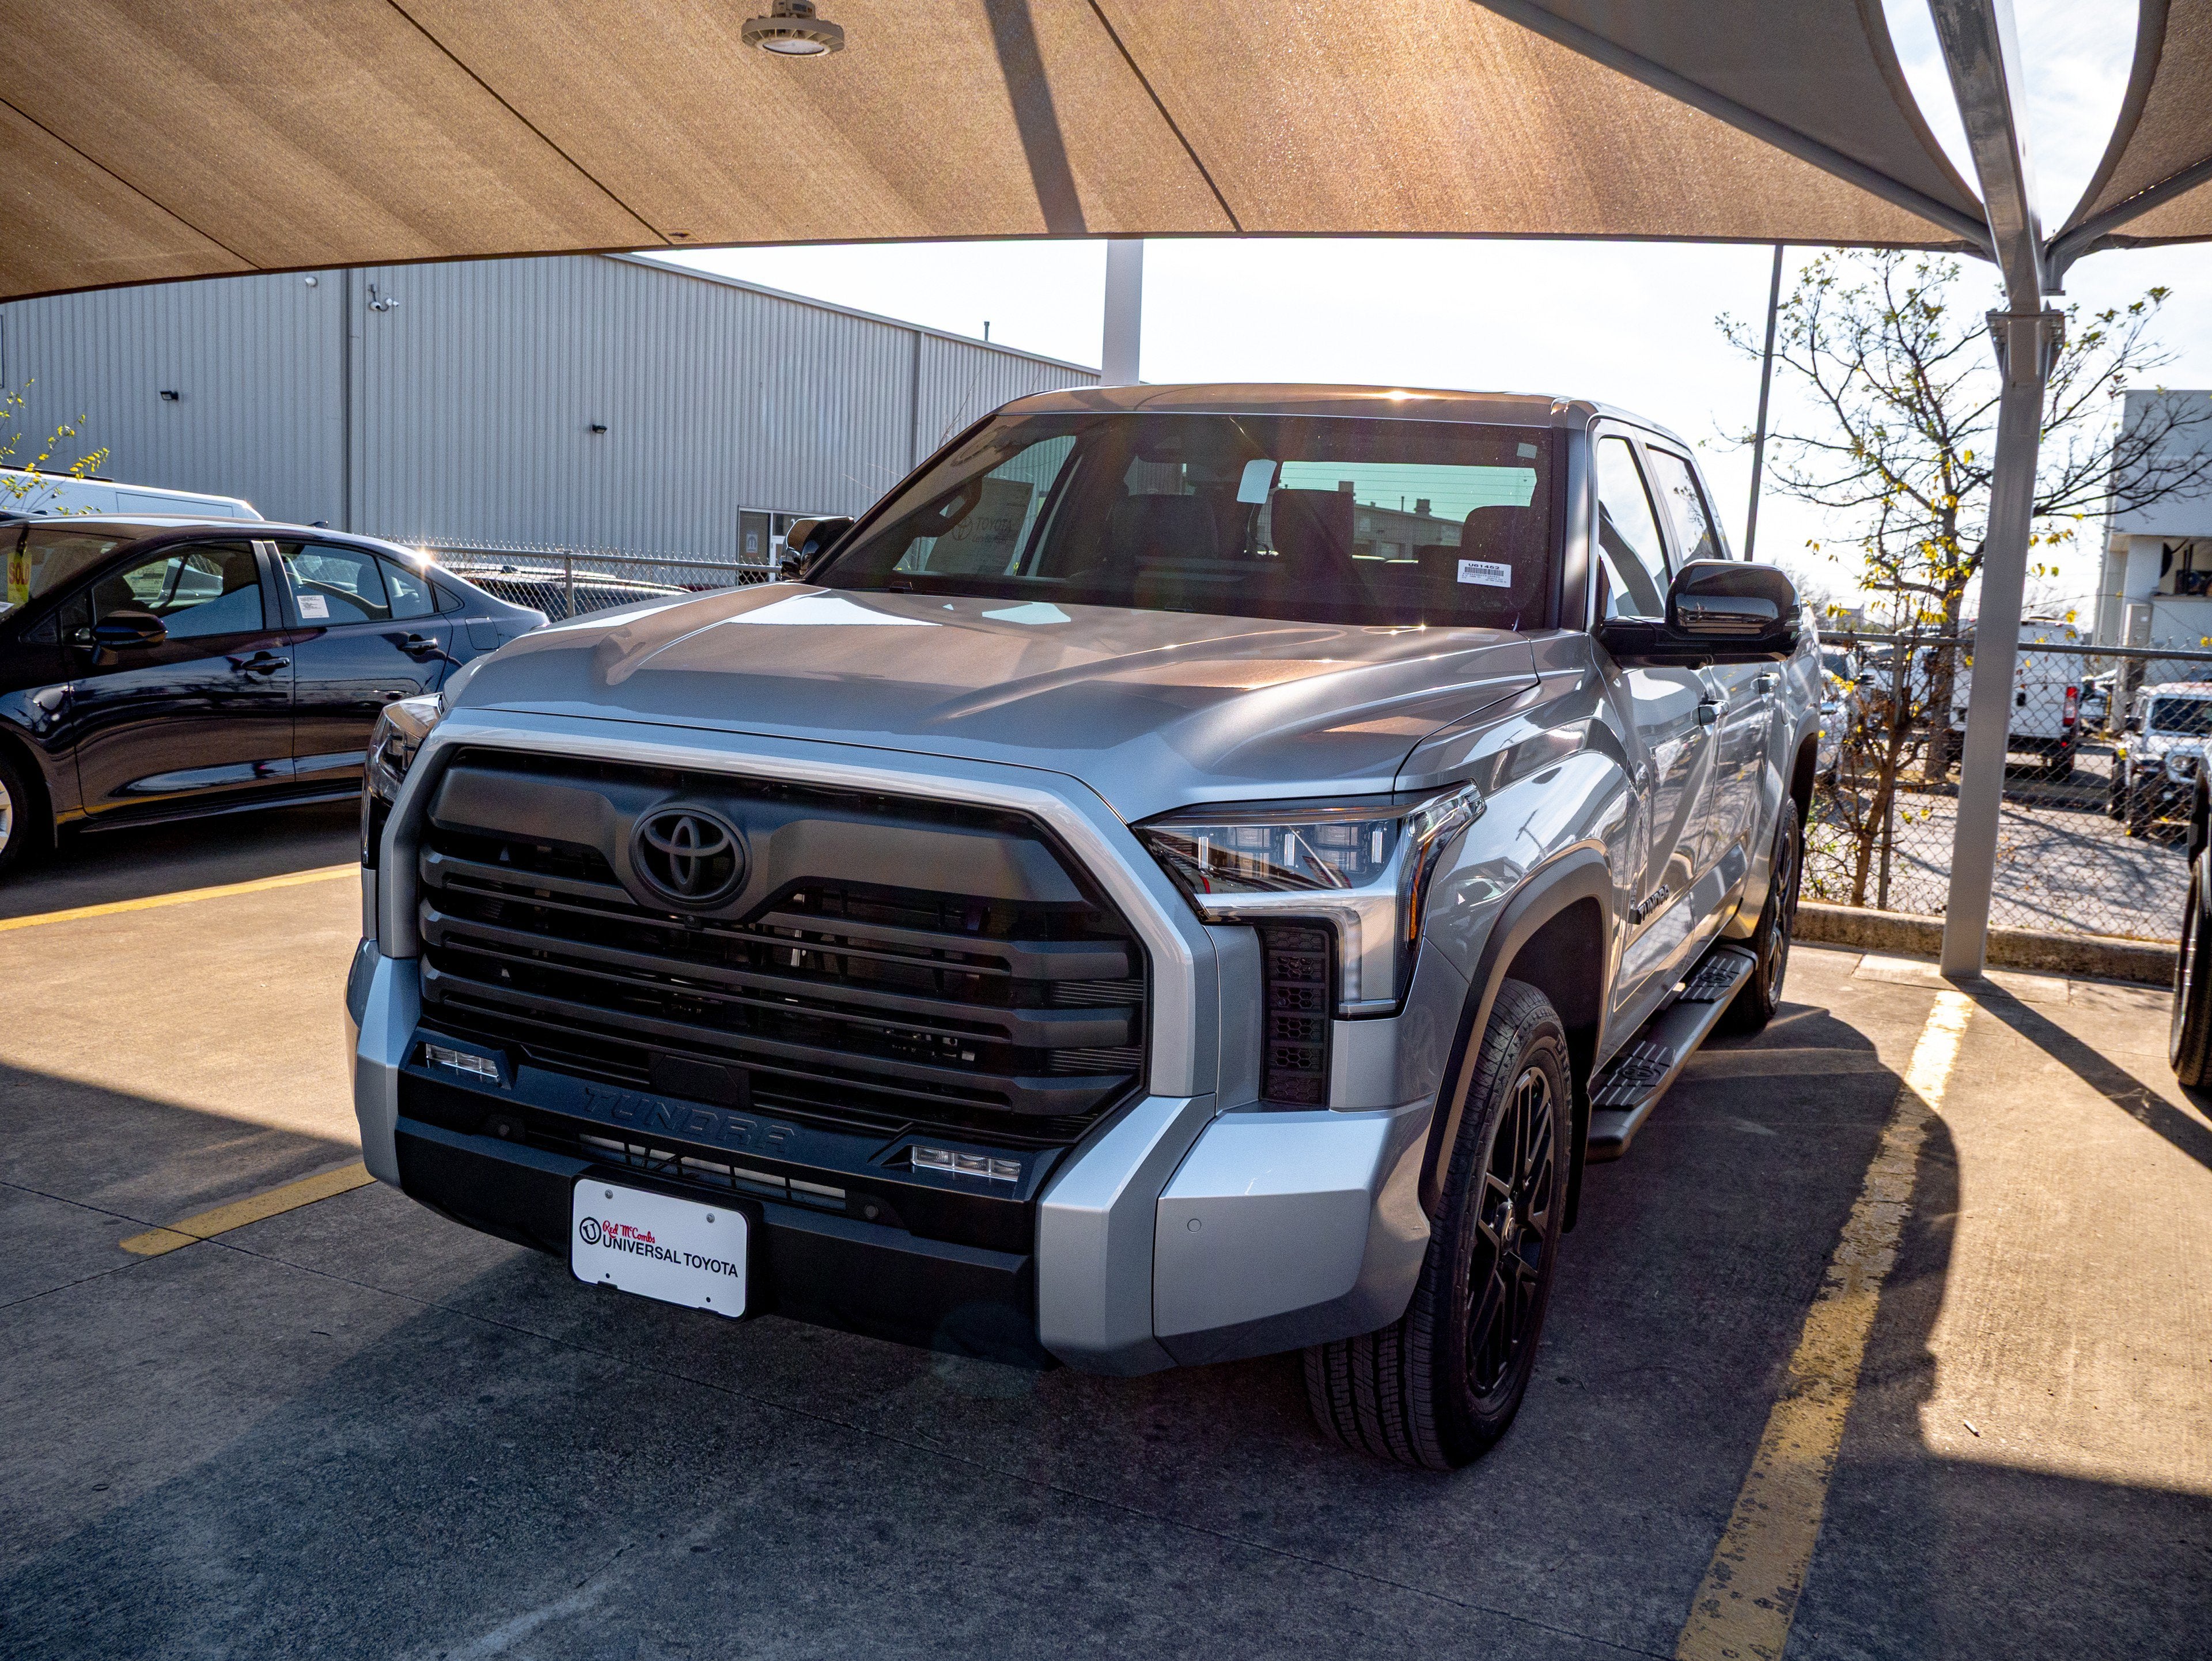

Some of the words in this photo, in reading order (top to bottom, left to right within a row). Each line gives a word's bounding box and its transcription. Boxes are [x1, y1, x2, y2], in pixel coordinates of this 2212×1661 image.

[9, 561, 30, 585] SOLD
[1638, 884, 1670, 921] TUNDRA
[584, 1086, 796, 1153] TUNDRA
[603, 1220, 619, 1239] Red
[620, 1224, 656, 1244] McCombs
[603, 1235, 681, 1264] UNIVERSAL
[683, 1253, 738, 1278] TOYOTA
